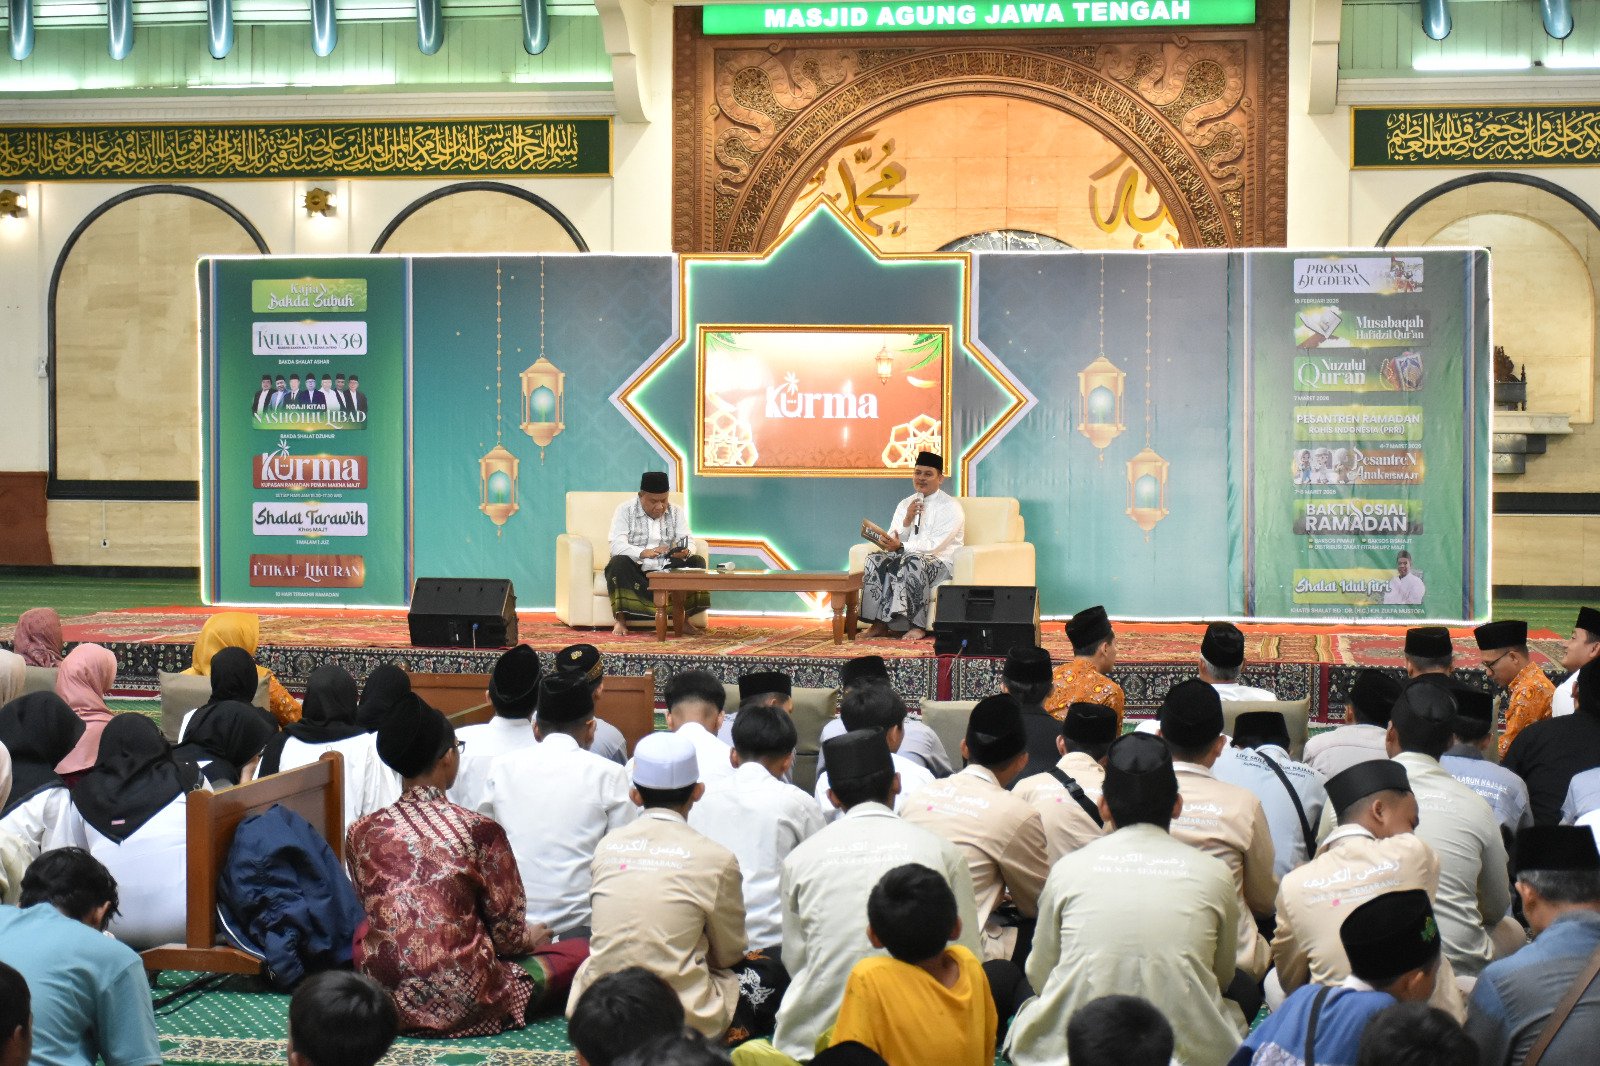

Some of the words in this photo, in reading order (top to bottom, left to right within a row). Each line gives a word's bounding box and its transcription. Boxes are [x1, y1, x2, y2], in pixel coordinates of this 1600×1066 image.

[764, 8, 869, 28] MASJID
[876, 5, 976, 26] AGUNG
[985, 3, 1065, 24] JAWA
[1073, 0, 1190, 22] TENGAH
[1306, 264, 1359, 274] PROSESI
[268, 292, 310, 309] Bakda
[313, 292, 355, 307] Subuh
[1356, 315, 1424, 331] Musabaqah
[1322, 358, 1366, 371] Nuzulul
[765, 378, 879, 419] Kurma
[1296, 414, 1360, 423] PESANTREN
[1362, 414, 1420, 423] RAMADAN
[1308, 426, 1334, 434] ROHIS
[1335, 426, 1379, 434] INDONESIA
[261, 449, 360, 481] Kurma
[254, 506, 303, 526] Shalat
[305, 509, 366, 526] Tarawih
[1306, 503, 1350, 516] BAKTI
[1305, 517, 1407, 532] RAMADAN
[304, 562, 361, 583] LIKURAN
[1295, 577, 1338, 593] Shalat
